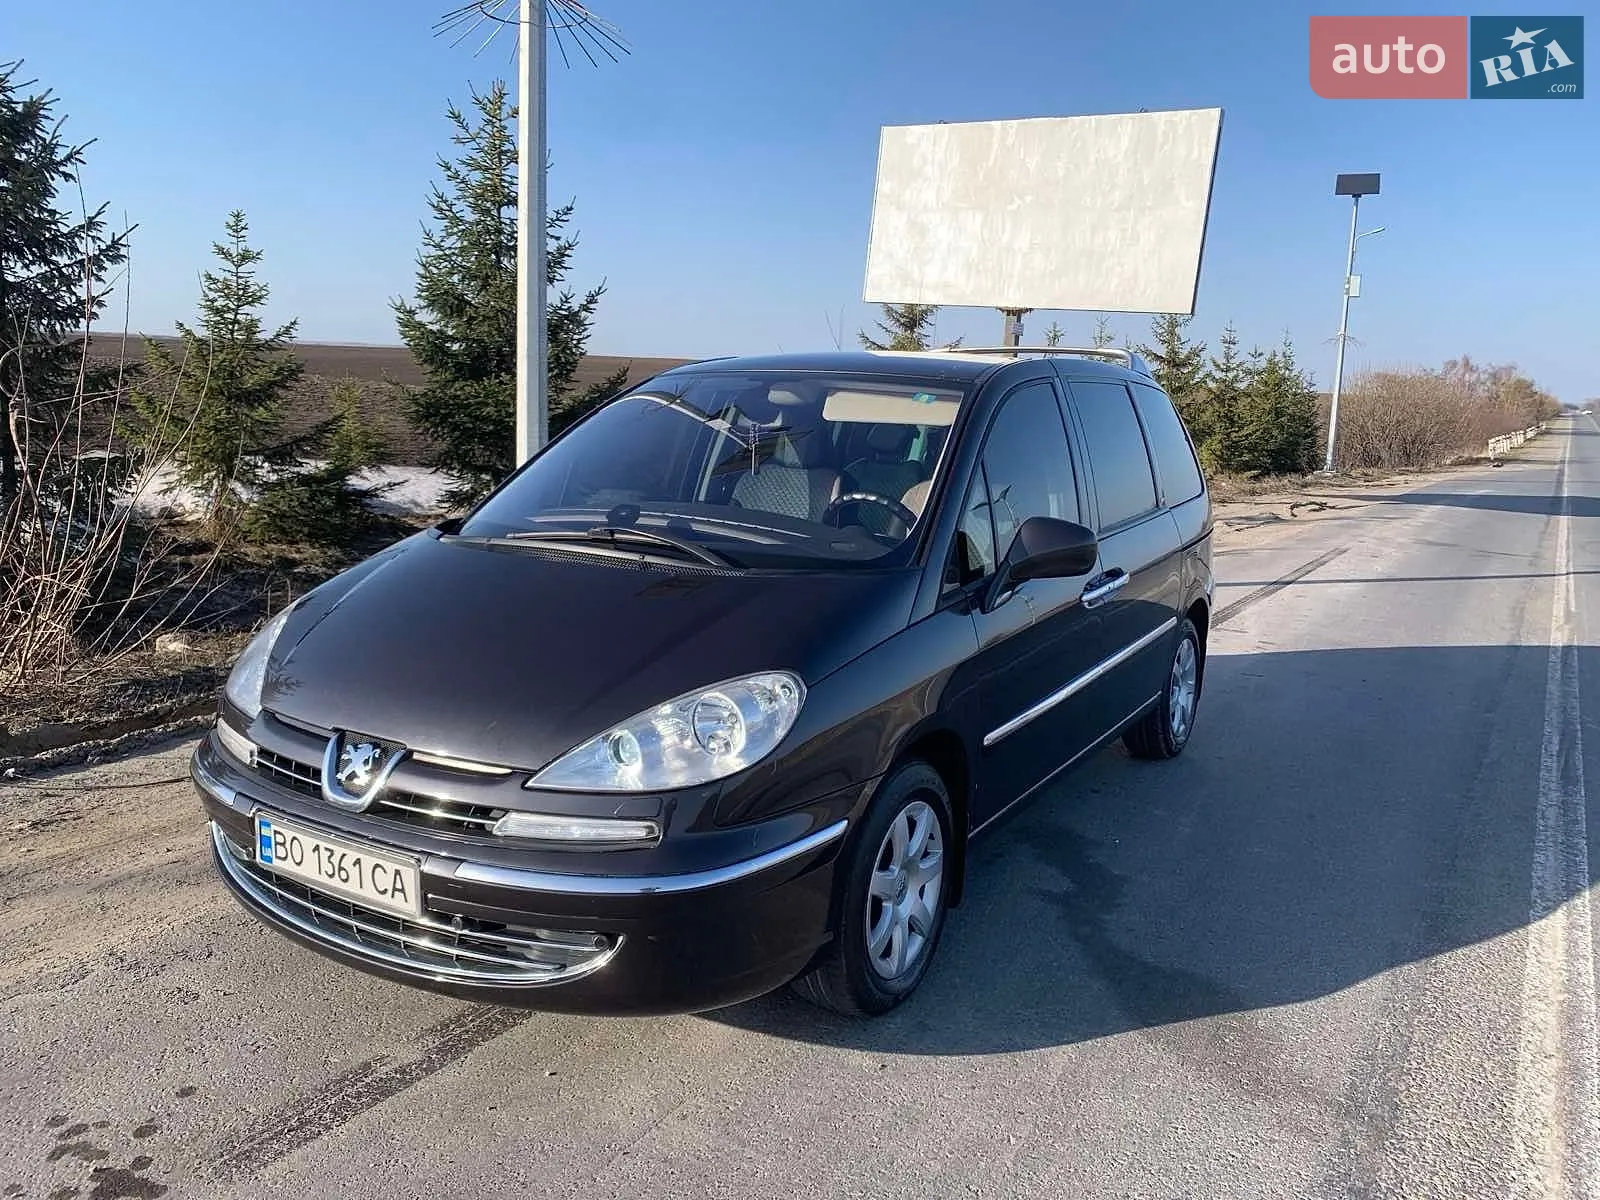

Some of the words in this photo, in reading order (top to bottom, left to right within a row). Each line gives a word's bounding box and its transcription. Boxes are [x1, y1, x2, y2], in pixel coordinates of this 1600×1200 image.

[273, 830, 304, 867] BO
[312, 844, 363, 889] 1361
[371, 863, 408, 903] CA
